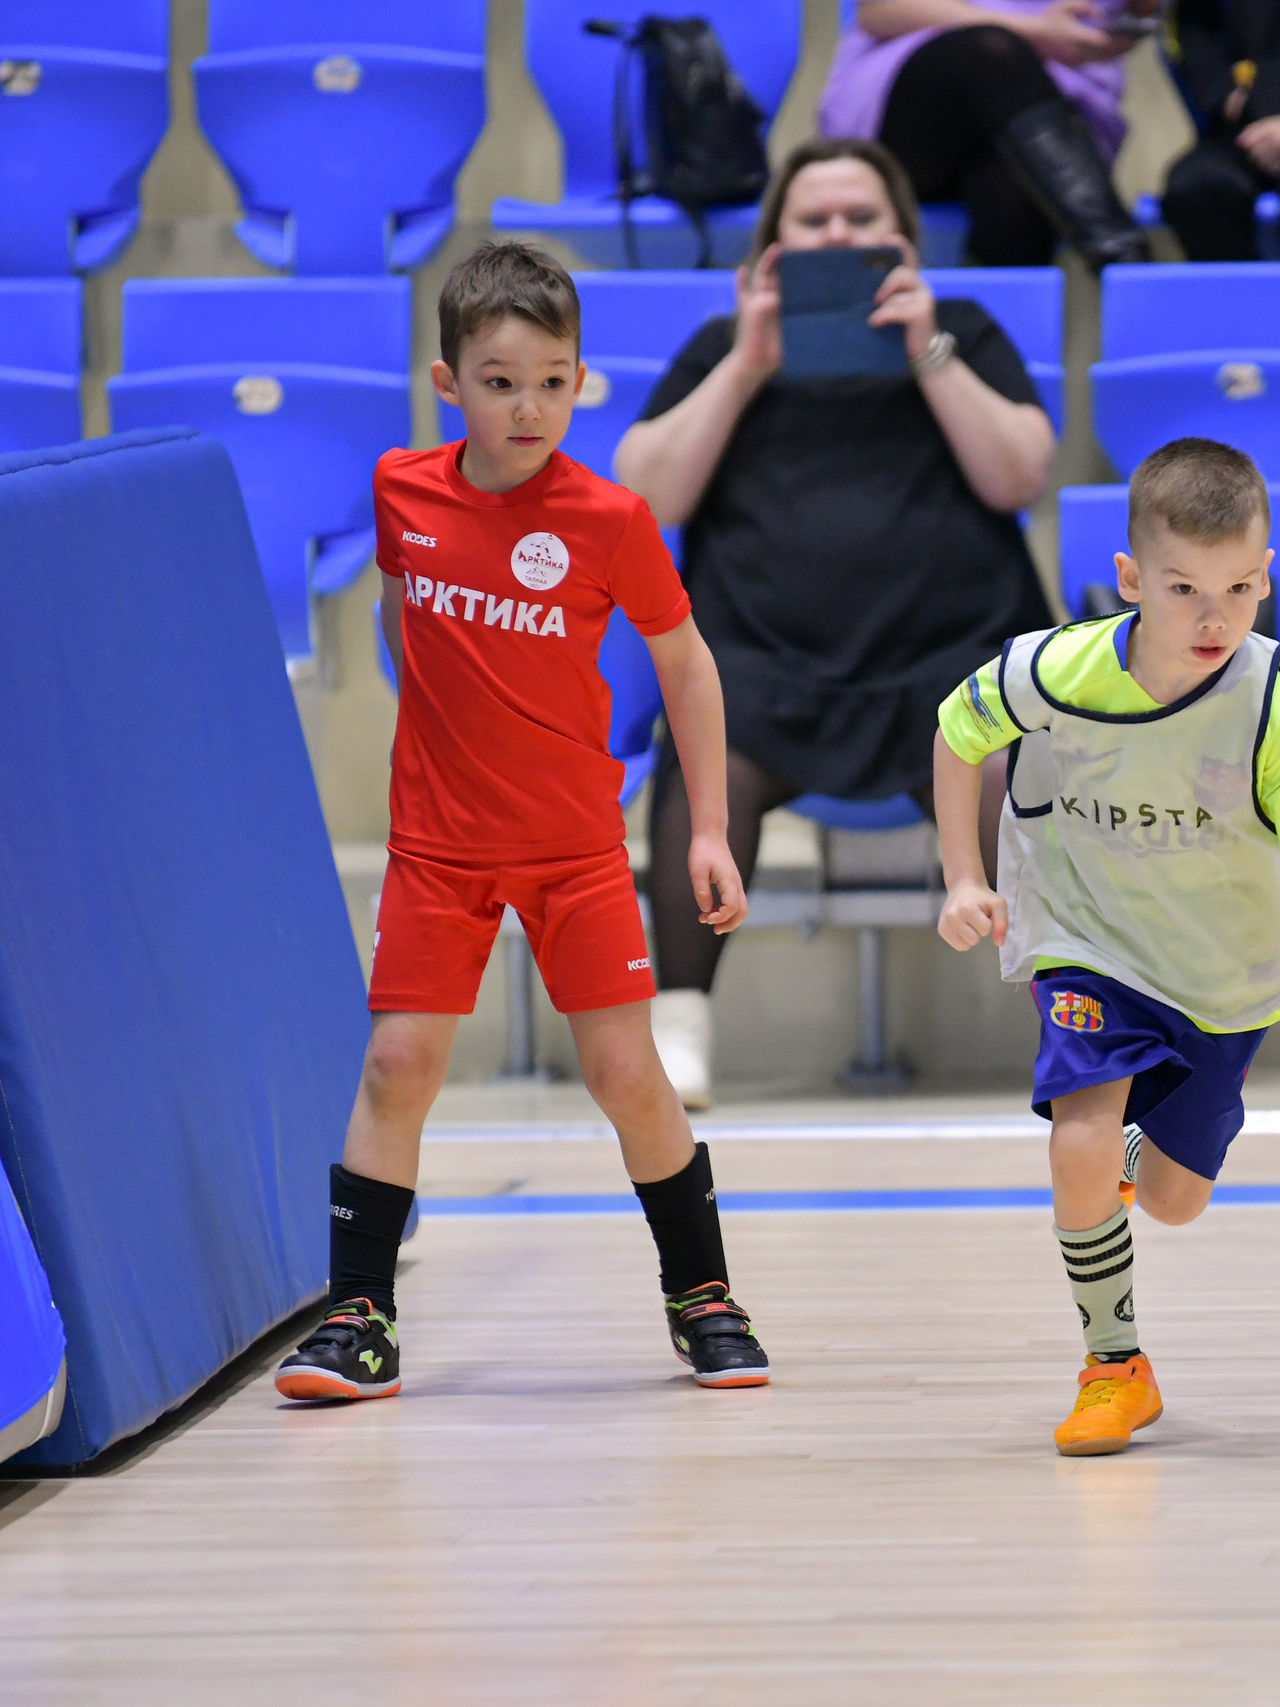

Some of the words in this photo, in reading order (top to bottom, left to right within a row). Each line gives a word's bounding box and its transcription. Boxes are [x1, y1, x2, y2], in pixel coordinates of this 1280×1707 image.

[402, 530, 437, 548] KODES
[518, 550, 564, 570] АРКТИКА
[403, 570, 567, 638] АРКТИКА
[1060, 795, 1213, 831] KIPSTA
